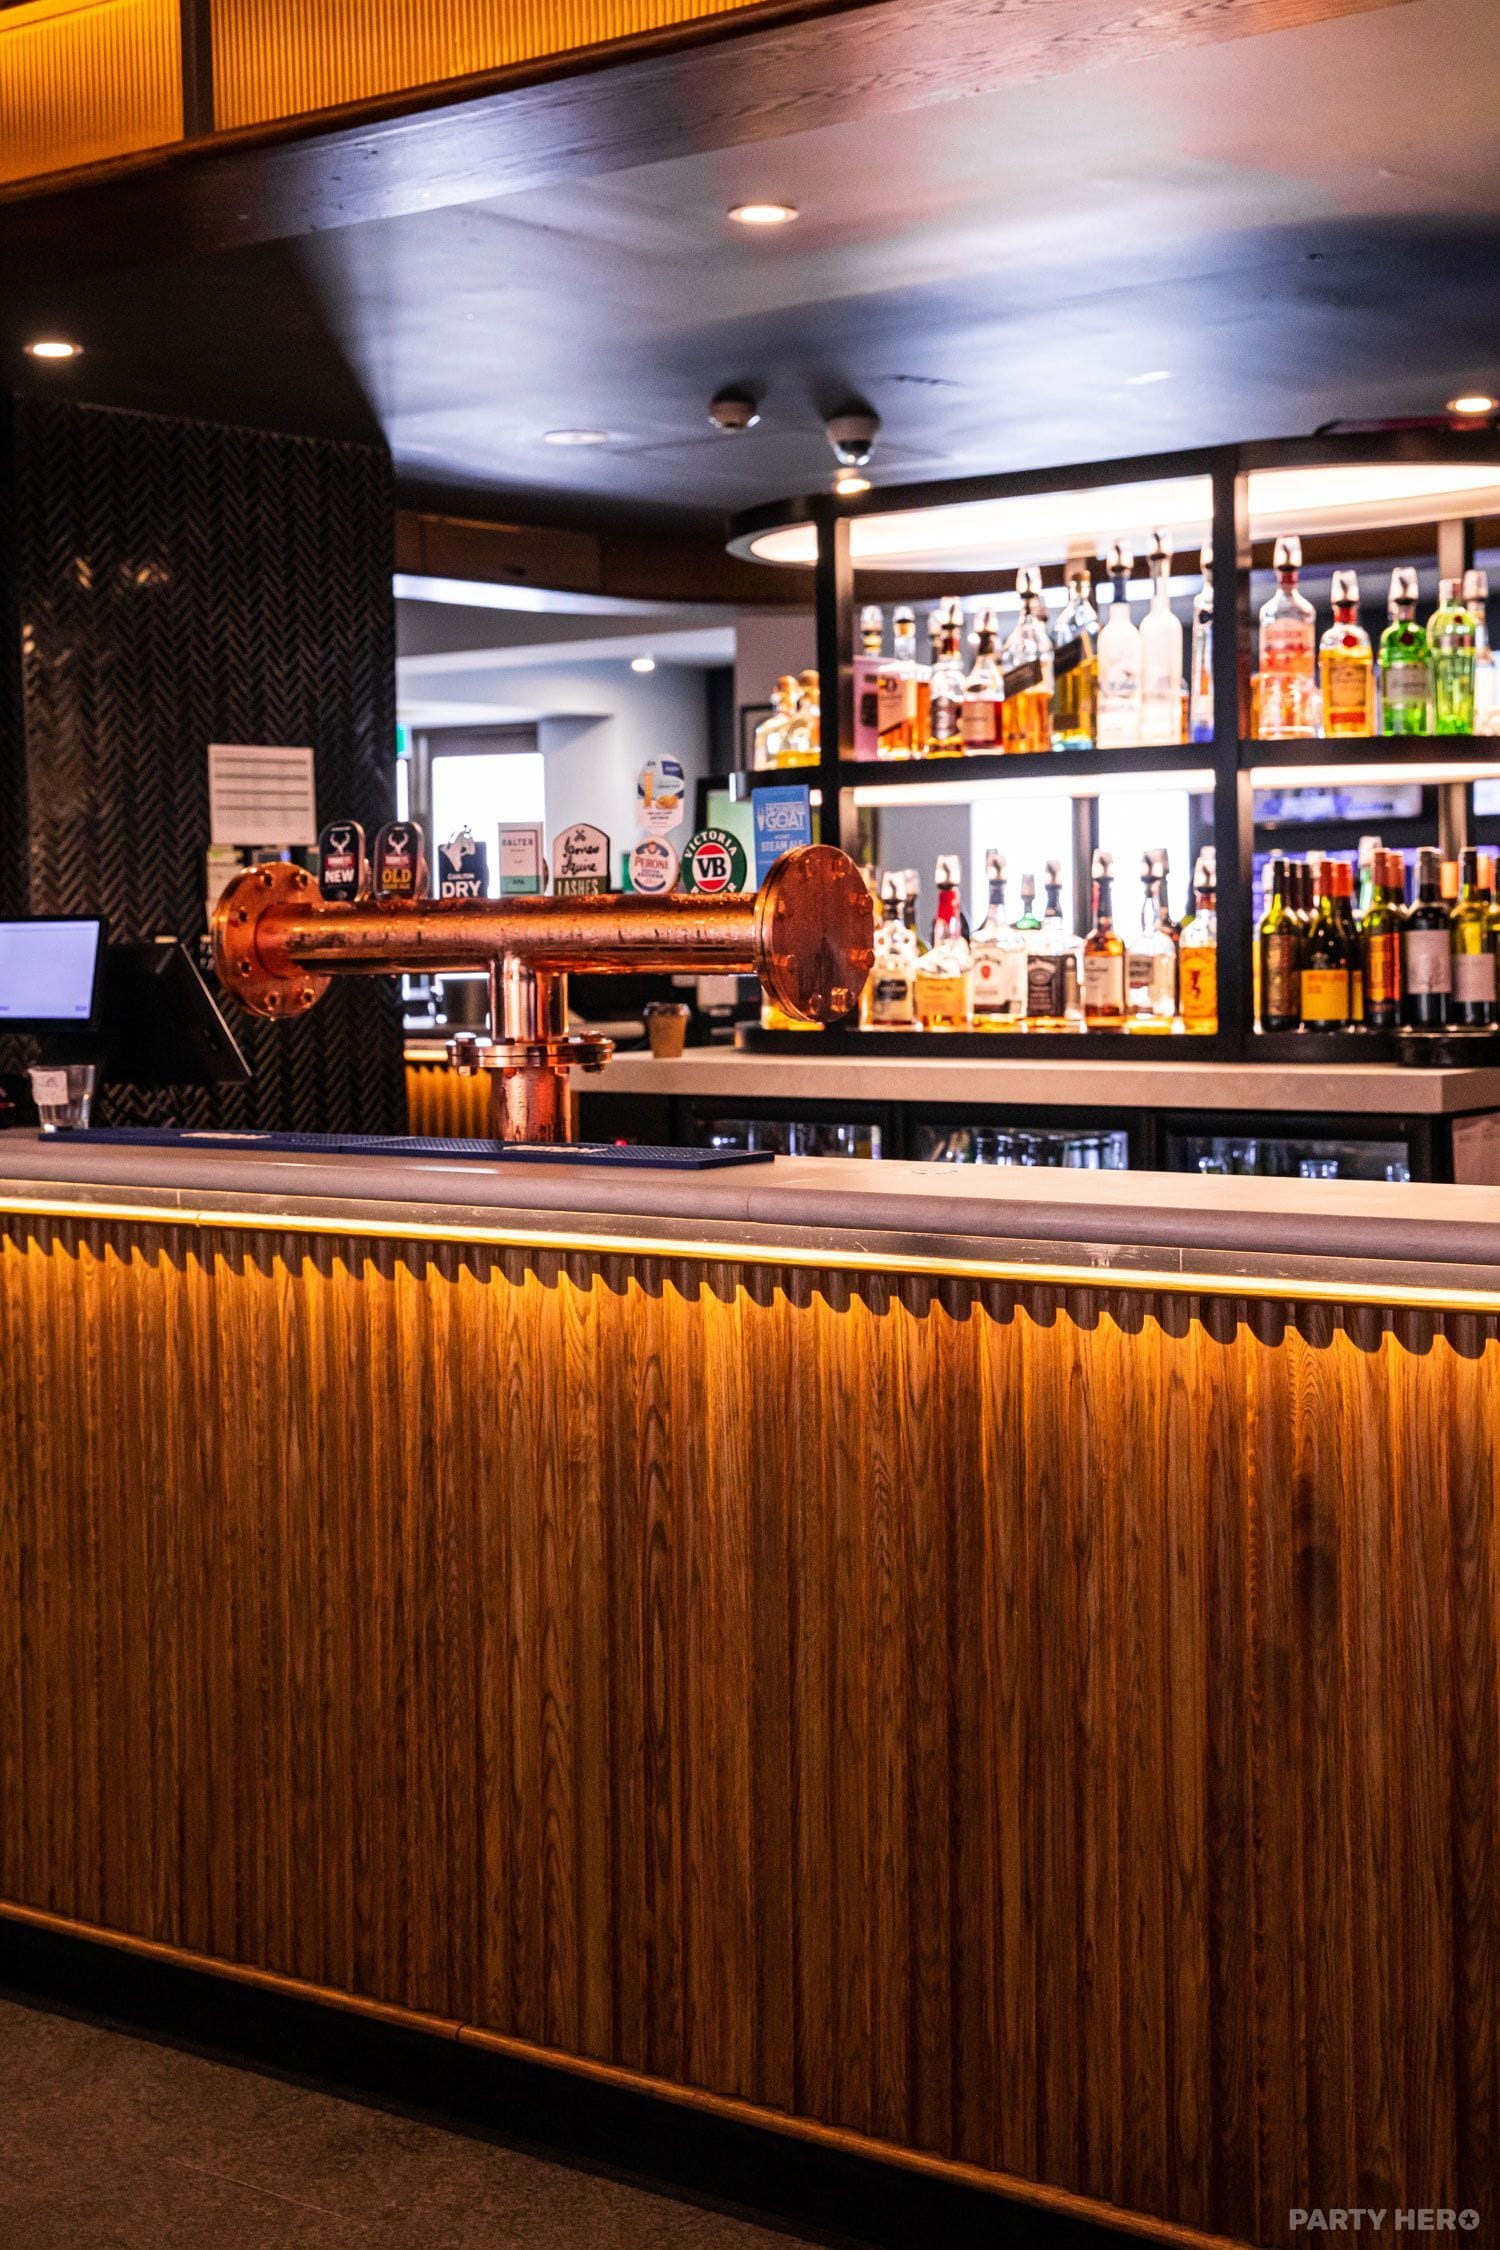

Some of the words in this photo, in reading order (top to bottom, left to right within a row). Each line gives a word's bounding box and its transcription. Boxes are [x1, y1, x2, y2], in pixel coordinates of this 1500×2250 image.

[766, 813, 804, 829] GOAT
[684, 830, 738, 858] VICTORIA
[634, 856, 669, 870] PERONI
[696, 857, 727, 879] VB
[325, 869, 354, 883] NEW
[382, 868, 412, 883] OLD
[442, 881, 481, 898] DRY
